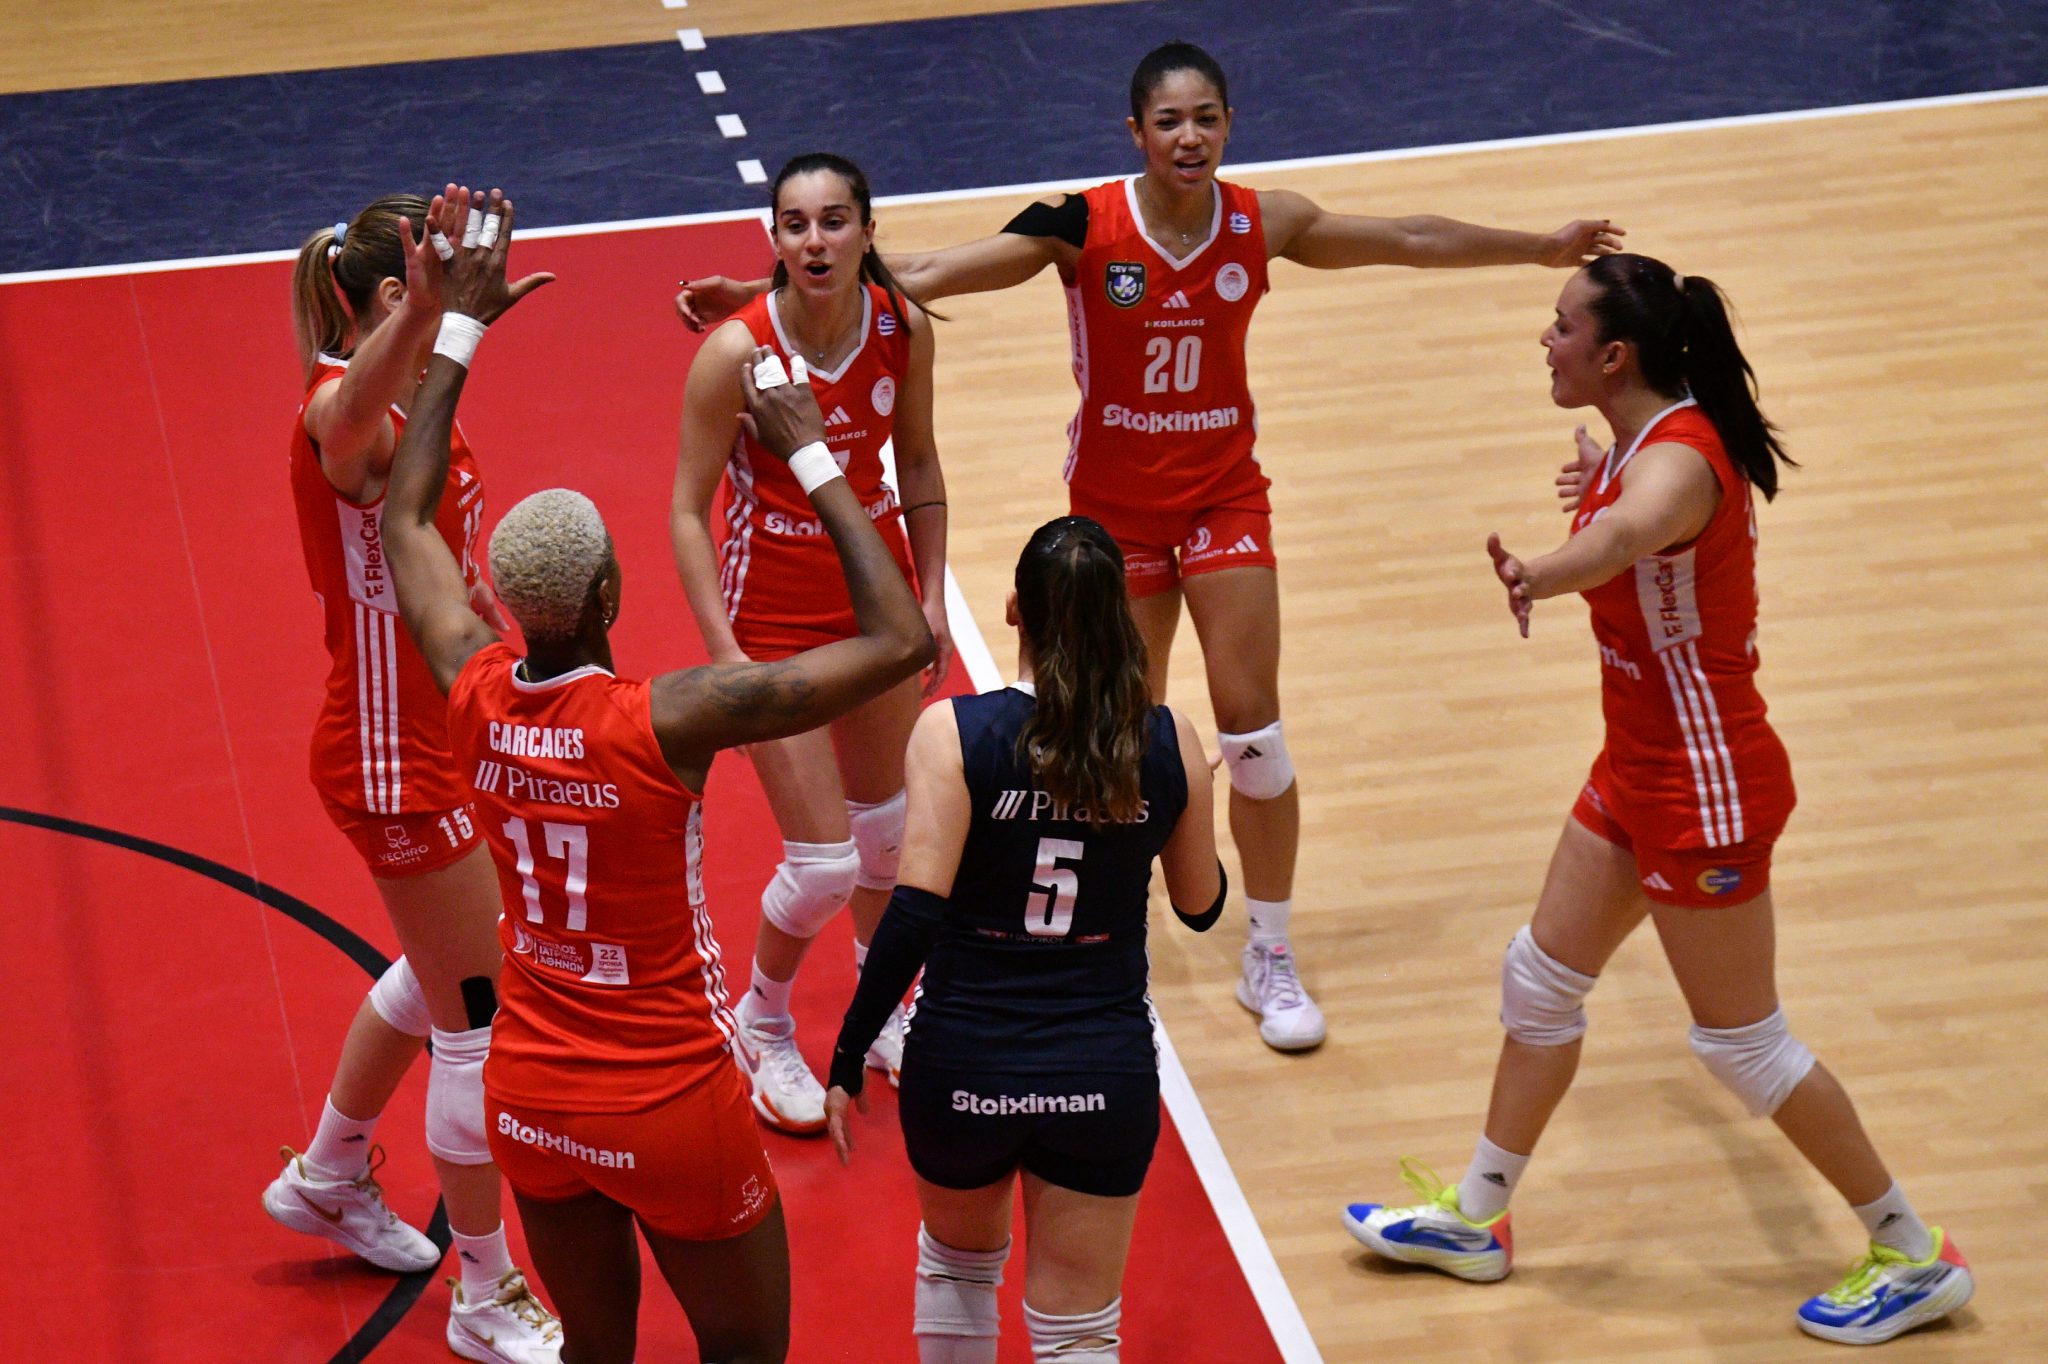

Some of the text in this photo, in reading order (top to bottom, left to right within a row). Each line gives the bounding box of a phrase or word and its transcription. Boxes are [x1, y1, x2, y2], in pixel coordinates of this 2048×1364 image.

[1109, 265, 1128, 273] CEV
[1152, 318, 1205, 328] KOILAKOS
[1143, 335, 1202, 394] 20
[1102, 403, 1239, 434] Stoiximan
[359, 511, 384, 581] FlexCar
[488, 720, 585, 760] CARCACES
[506, 765, 621, 809] Piraeus
[438, 807, 475, 848] 15
[378, 844, 429, 862] VECHRO
[502, 815, 589, 932] 17
[1023, 836, 1085, 937] 5
[539, 955, 585, 974] ΑΘΗΝΩΝ
[600, 949, 619, 960] 22
[951, 1089, 1107, 1115] Stoiximan
[497, 1111, 636, 1169] Stoiximan
